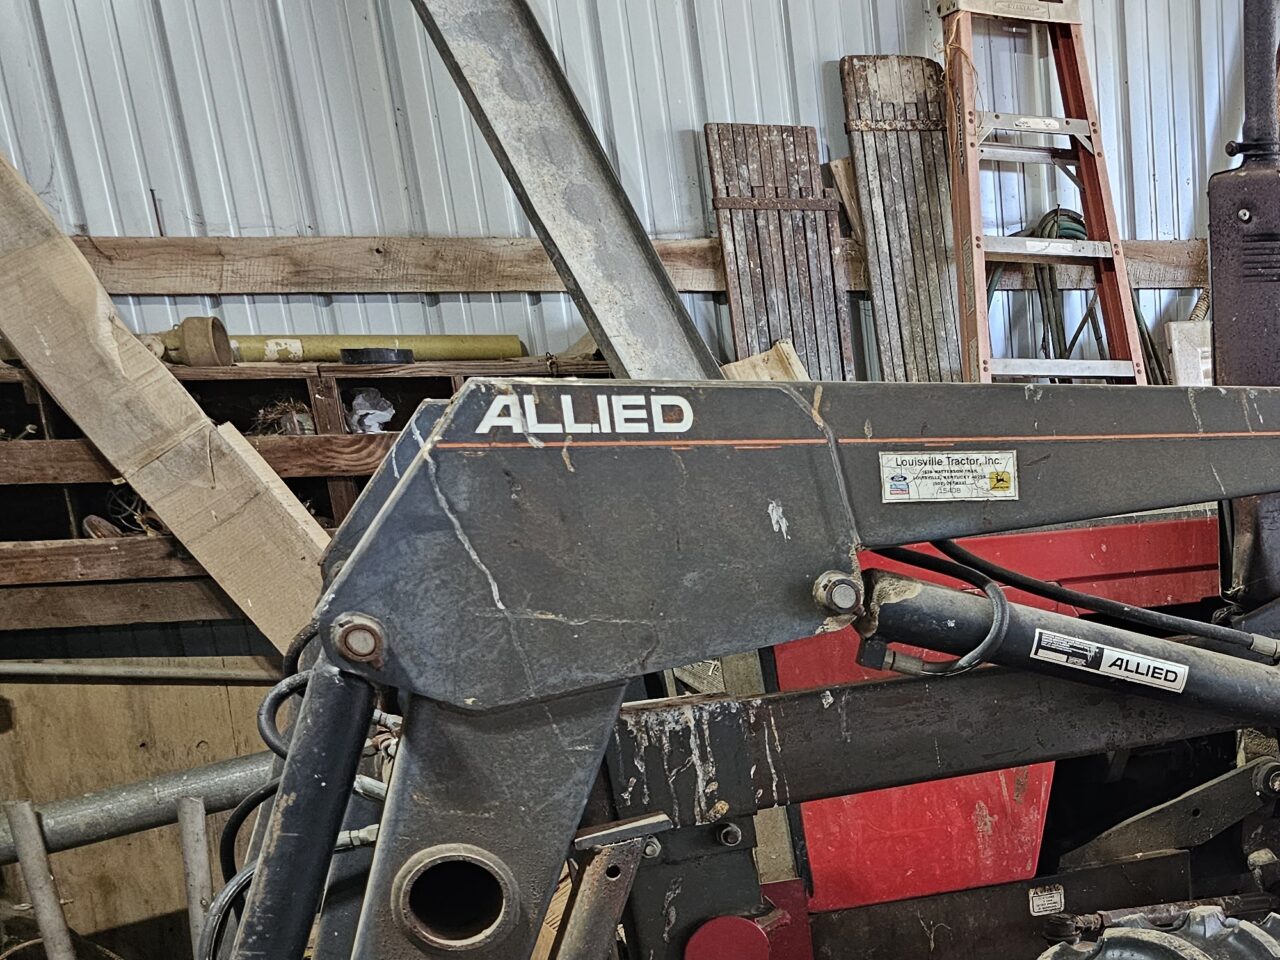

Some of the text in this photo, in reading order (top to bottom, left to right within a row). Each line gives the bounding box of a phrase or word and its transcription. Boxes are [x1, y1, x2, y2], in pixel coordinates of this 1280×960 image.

[475, 394, 694, 434] ALLIED
[896, 455, 1002, 467] Louisville Tractor, Inc.
[1108, 657, 1178, 683] ALLIED
